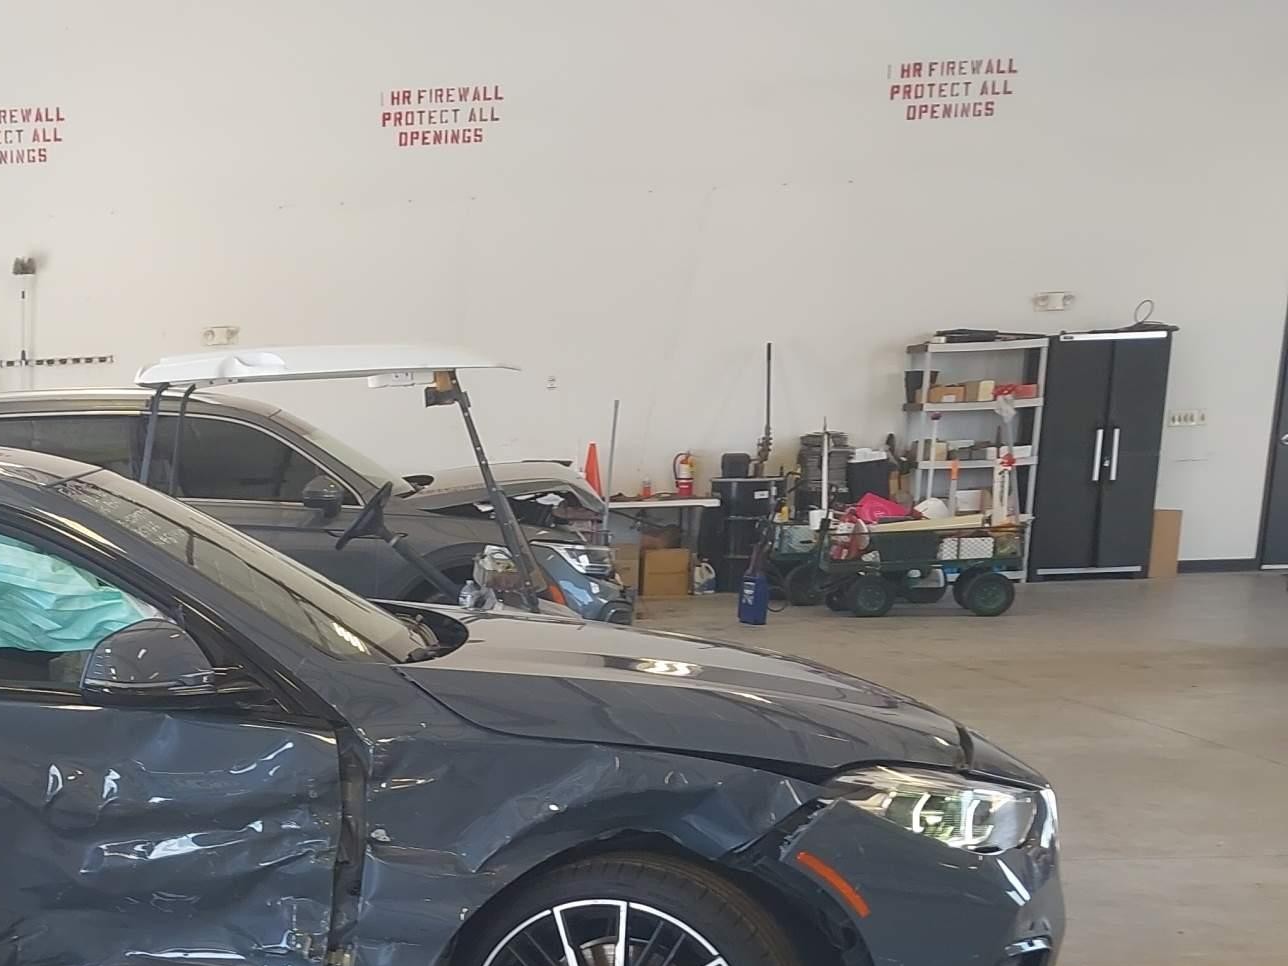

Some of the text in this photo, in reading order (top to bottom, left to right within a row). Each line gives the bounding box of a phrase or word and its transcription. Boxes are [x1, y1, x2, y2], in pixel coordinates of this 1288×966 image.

[900, 62, 923, 79] HR
[928, 58, 1018, 77] FIREWALL
[391, 90, 412, 106] HR
[417, 85, 504, 104] FIREWALL
[890, 79, 1013, 100] PROTECT ALL
[381, 107, 500, 127] PROTECT ALL
[906, 101, 995, 120] OPENINGS
[32, 127, 63, 143] ALL
[399, 128, 483, 147] OPENINGS
